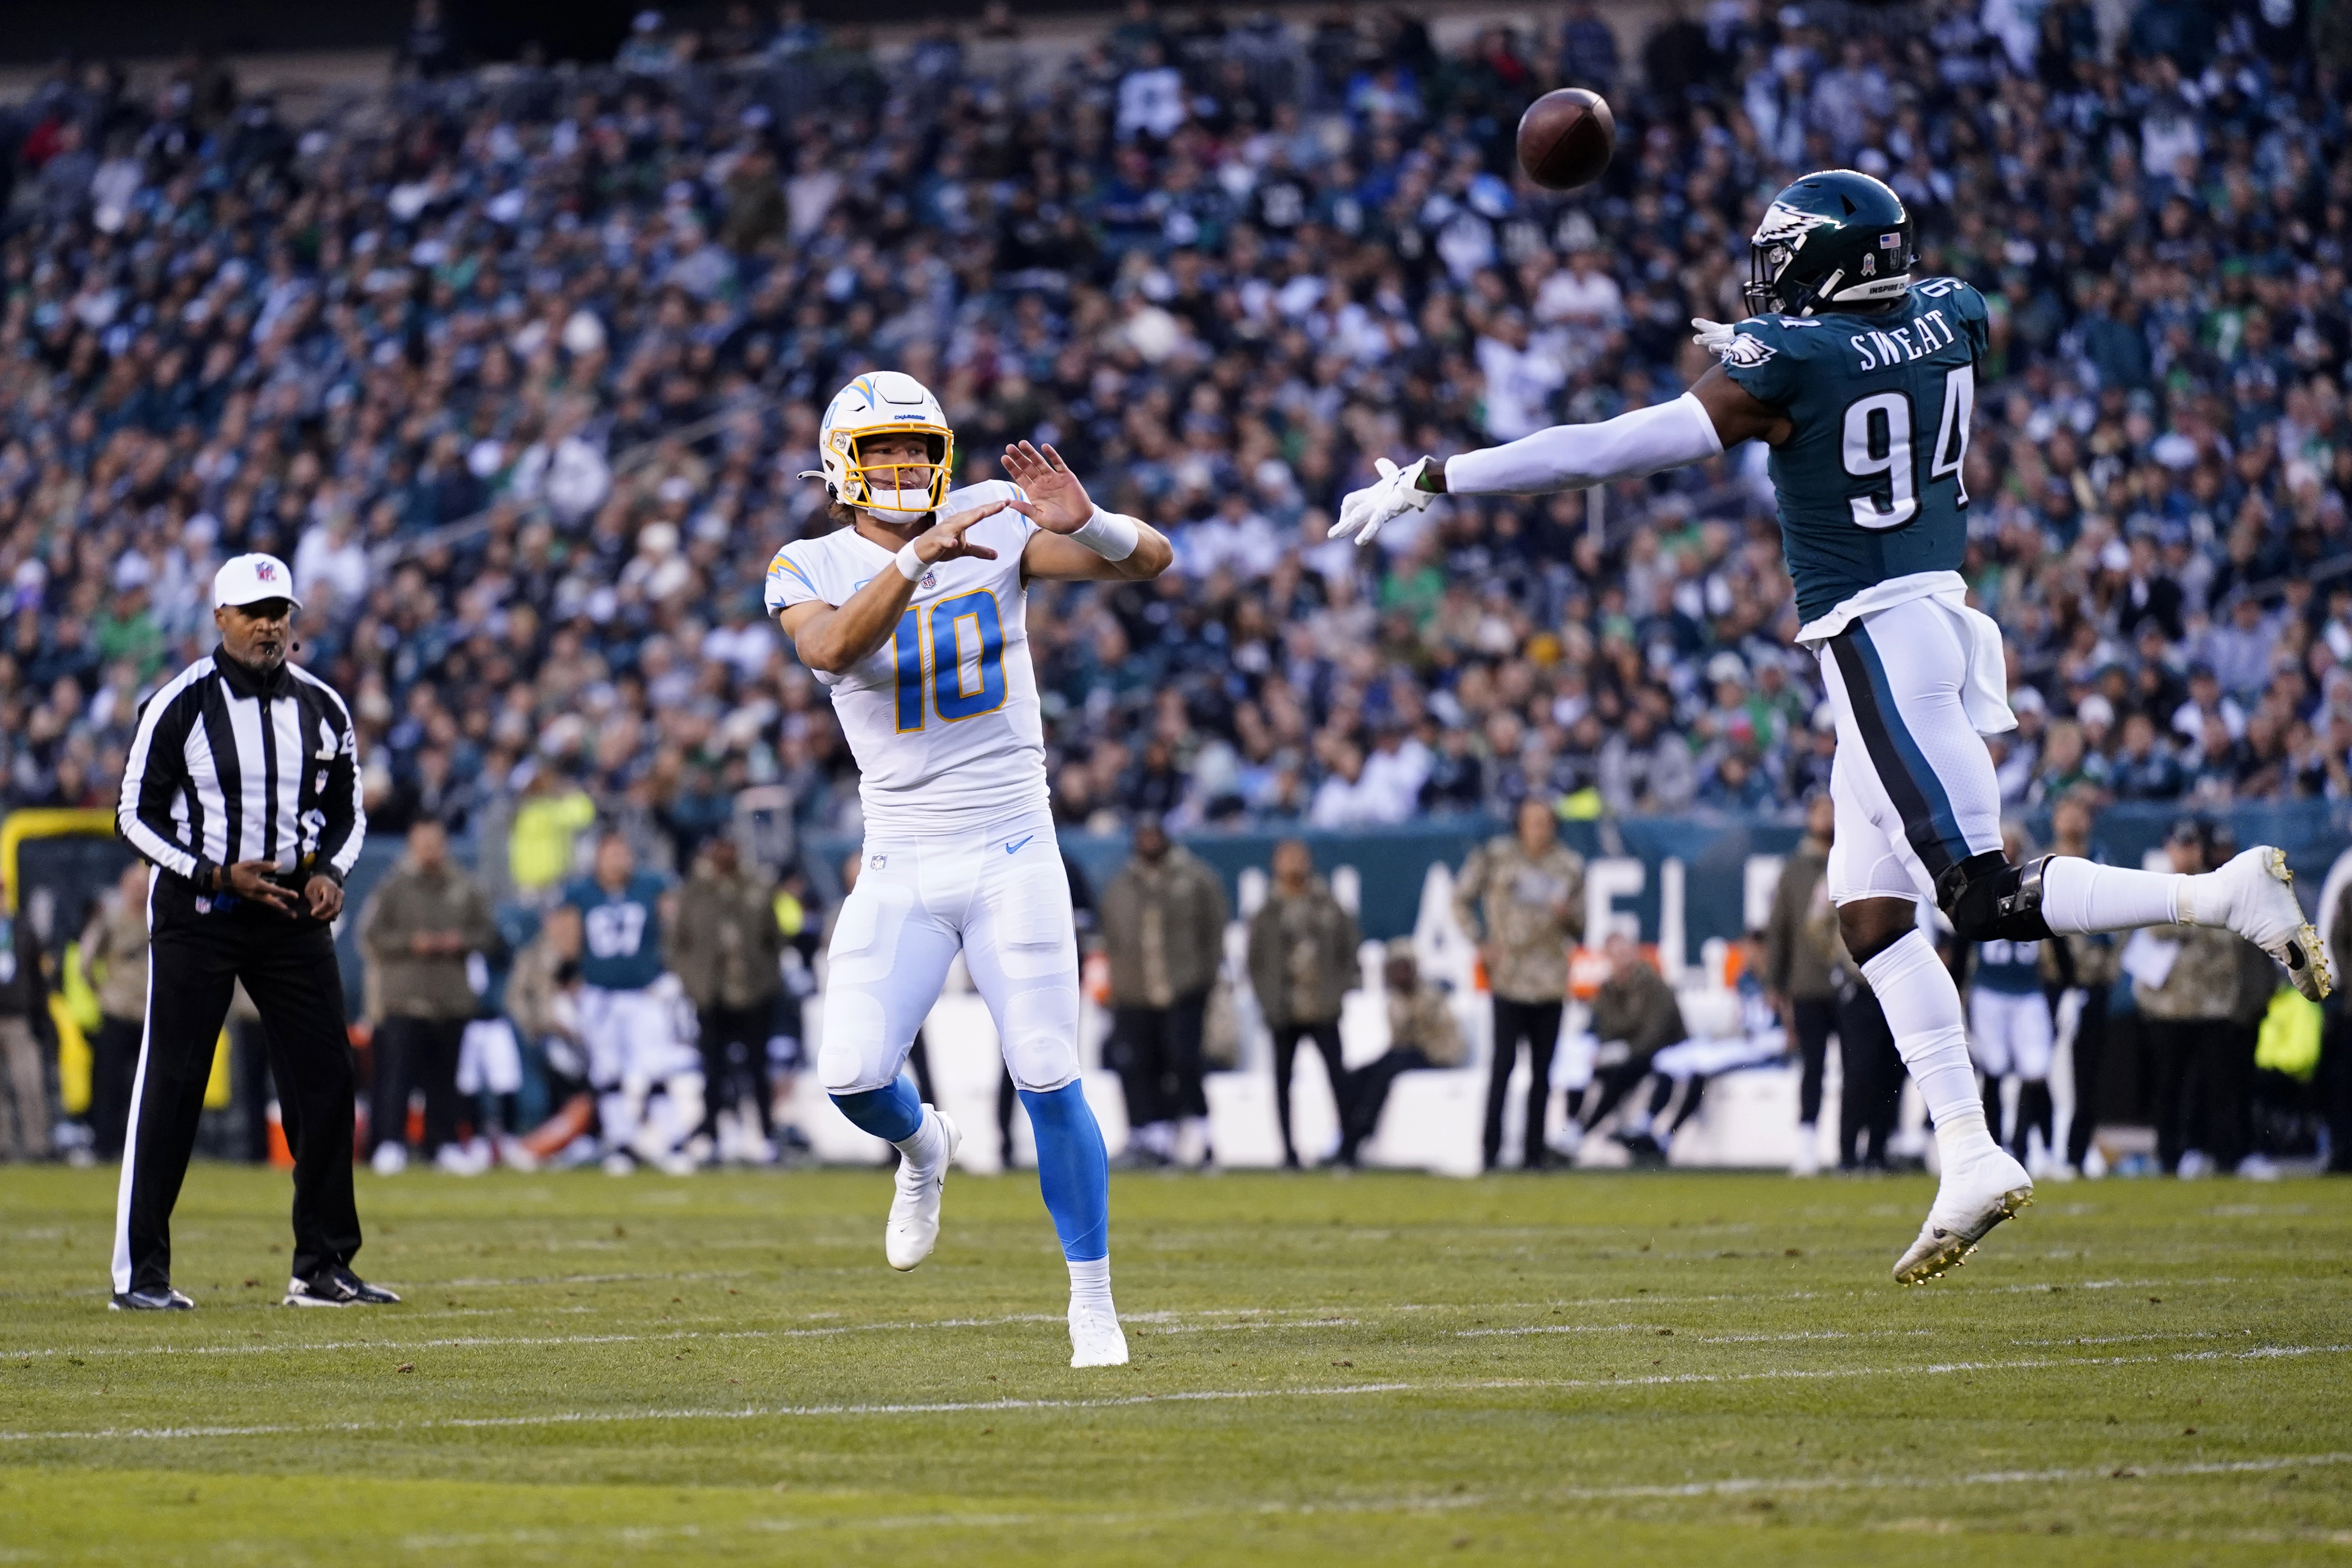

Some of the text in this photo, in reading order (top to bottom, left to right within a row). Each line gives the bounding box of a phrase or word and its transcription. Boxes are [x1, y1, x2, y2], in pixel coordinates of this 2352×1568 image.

[1870, 284, 1898, 294] INSPIRE
[1850, 309, 1955, 372] SWEAT
[1840, 365, 1974, 531] 94
[923, 578, 935, 587] NFL
[893, 588, 1009, 734] 10
